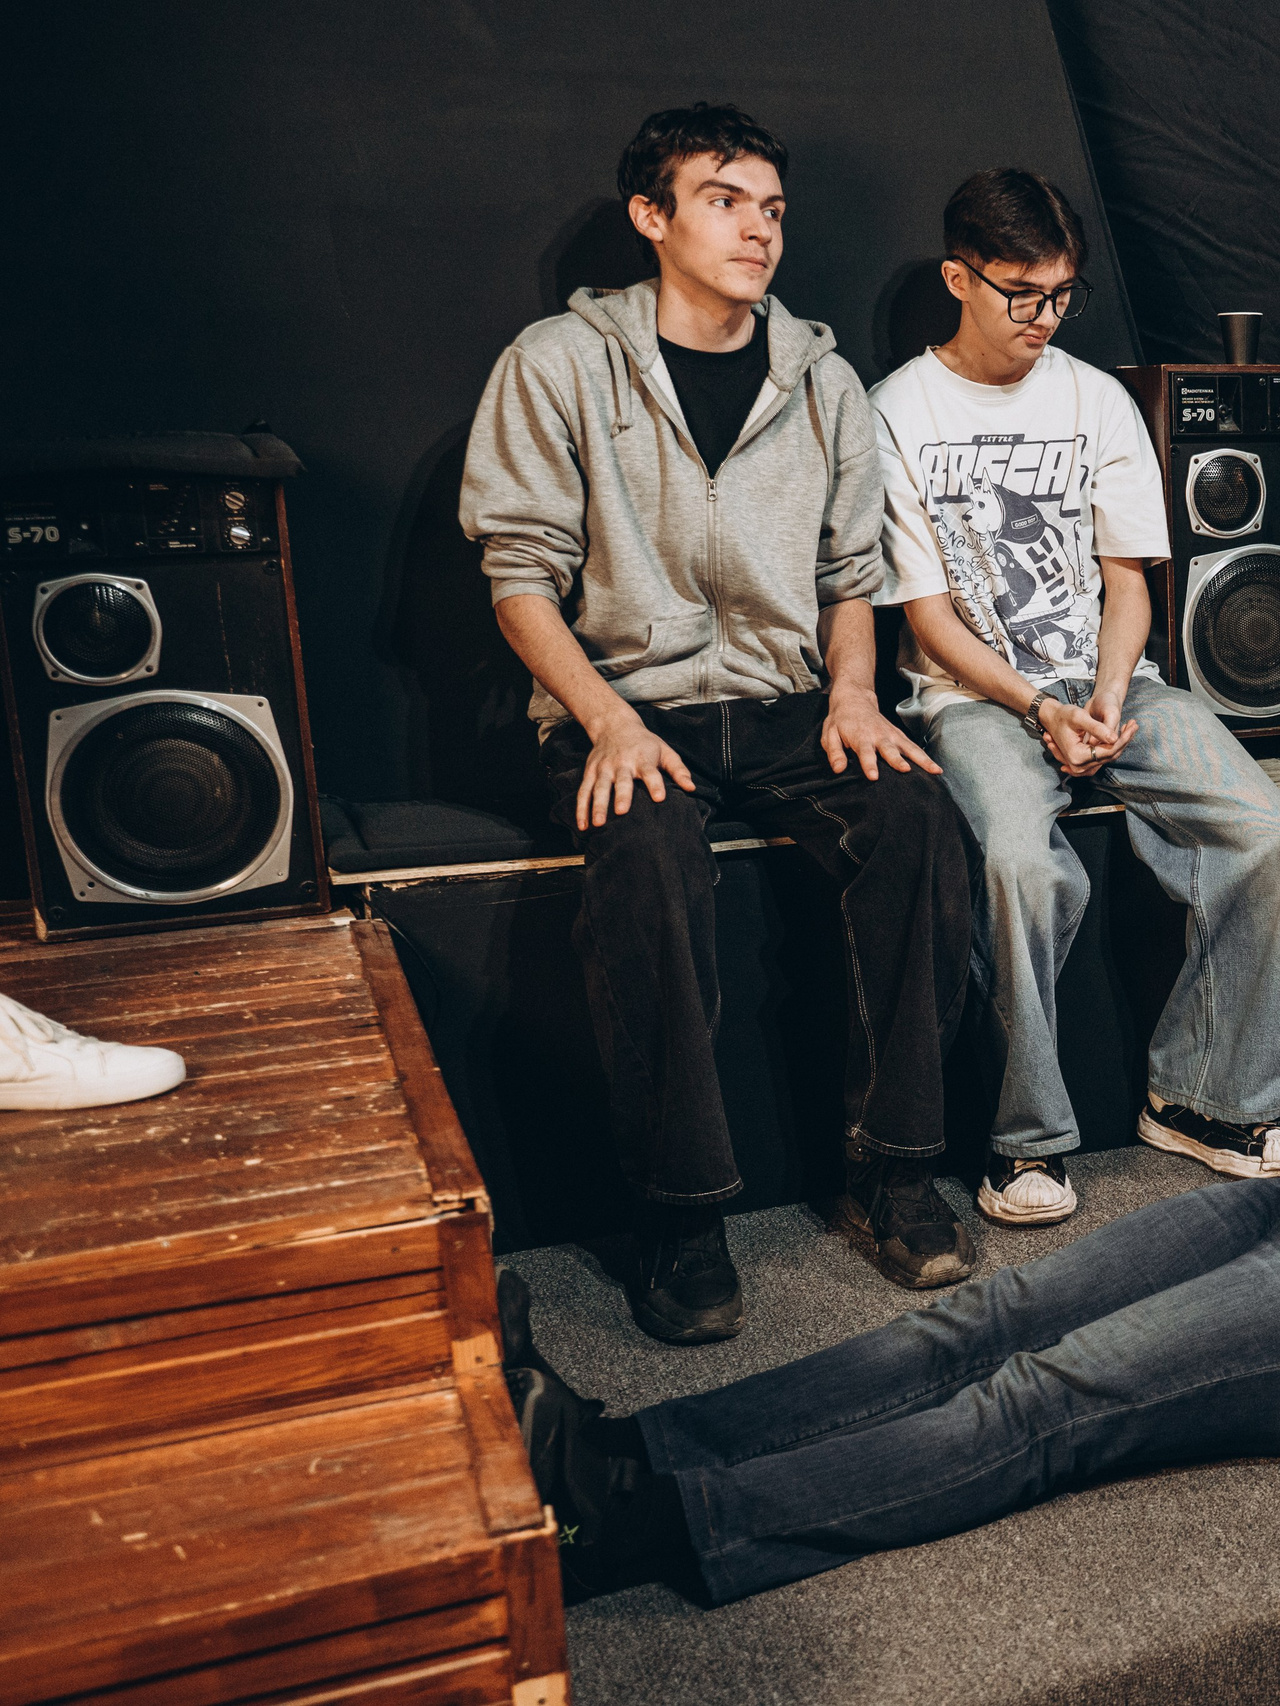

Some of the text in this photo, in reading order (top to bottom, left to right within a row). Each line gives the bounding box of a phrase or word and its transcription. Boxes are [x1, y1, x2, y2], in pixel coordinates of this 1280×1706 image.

[1182, 408, 1215, 422] S-70
[980, 435, 1014, 443] LITTLE
[8, 526, 60, 543] S-70
